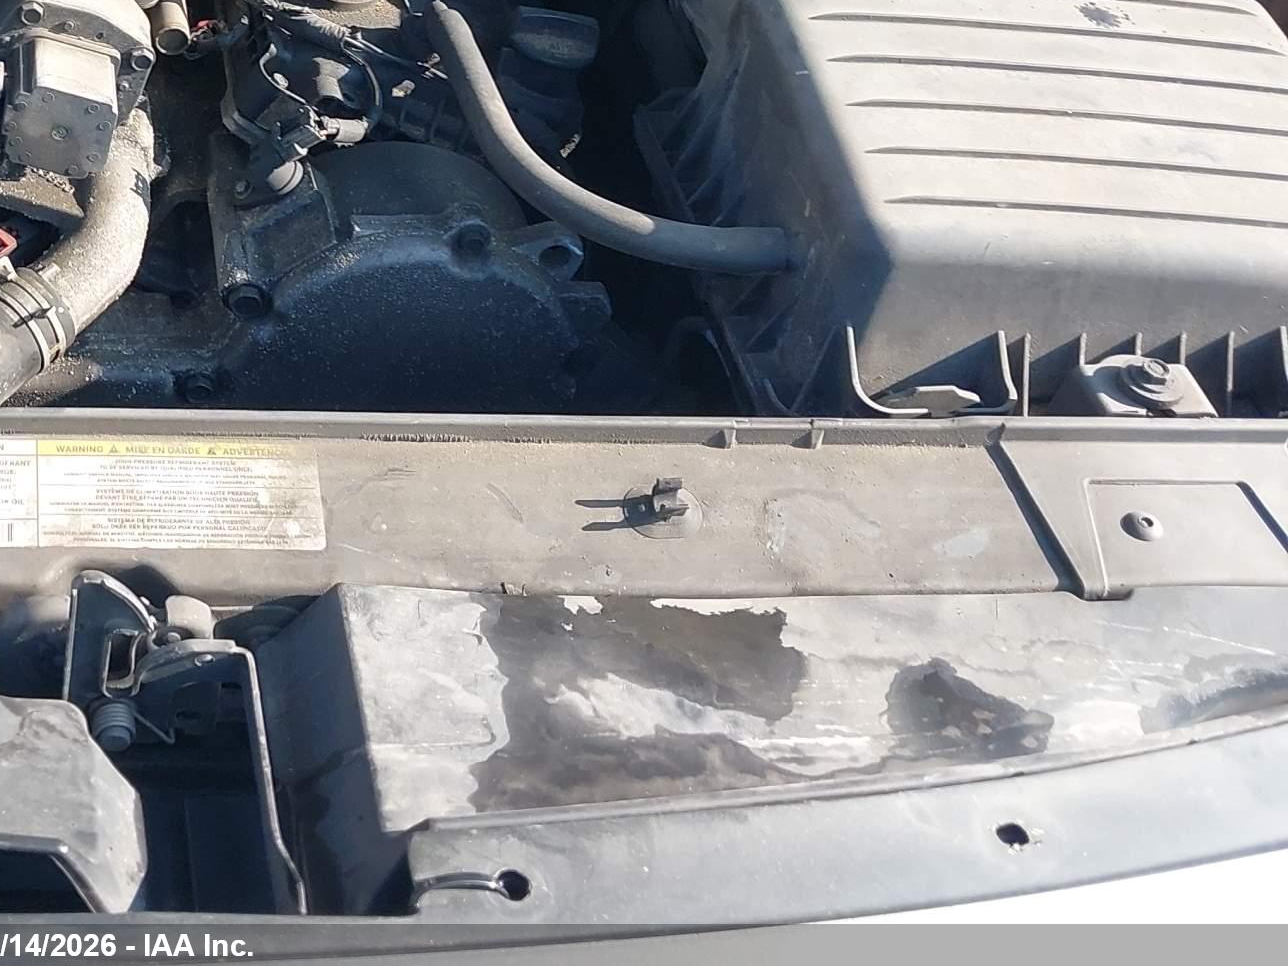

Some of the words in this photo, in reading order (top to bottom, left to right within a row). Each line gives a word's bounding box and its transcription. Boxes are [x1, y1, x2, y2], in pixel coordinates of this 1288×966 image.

[55, 445, 104, 453] WARNING
[125, 445, 150, 454] MISE
[152, 446, 166, 455] EN
